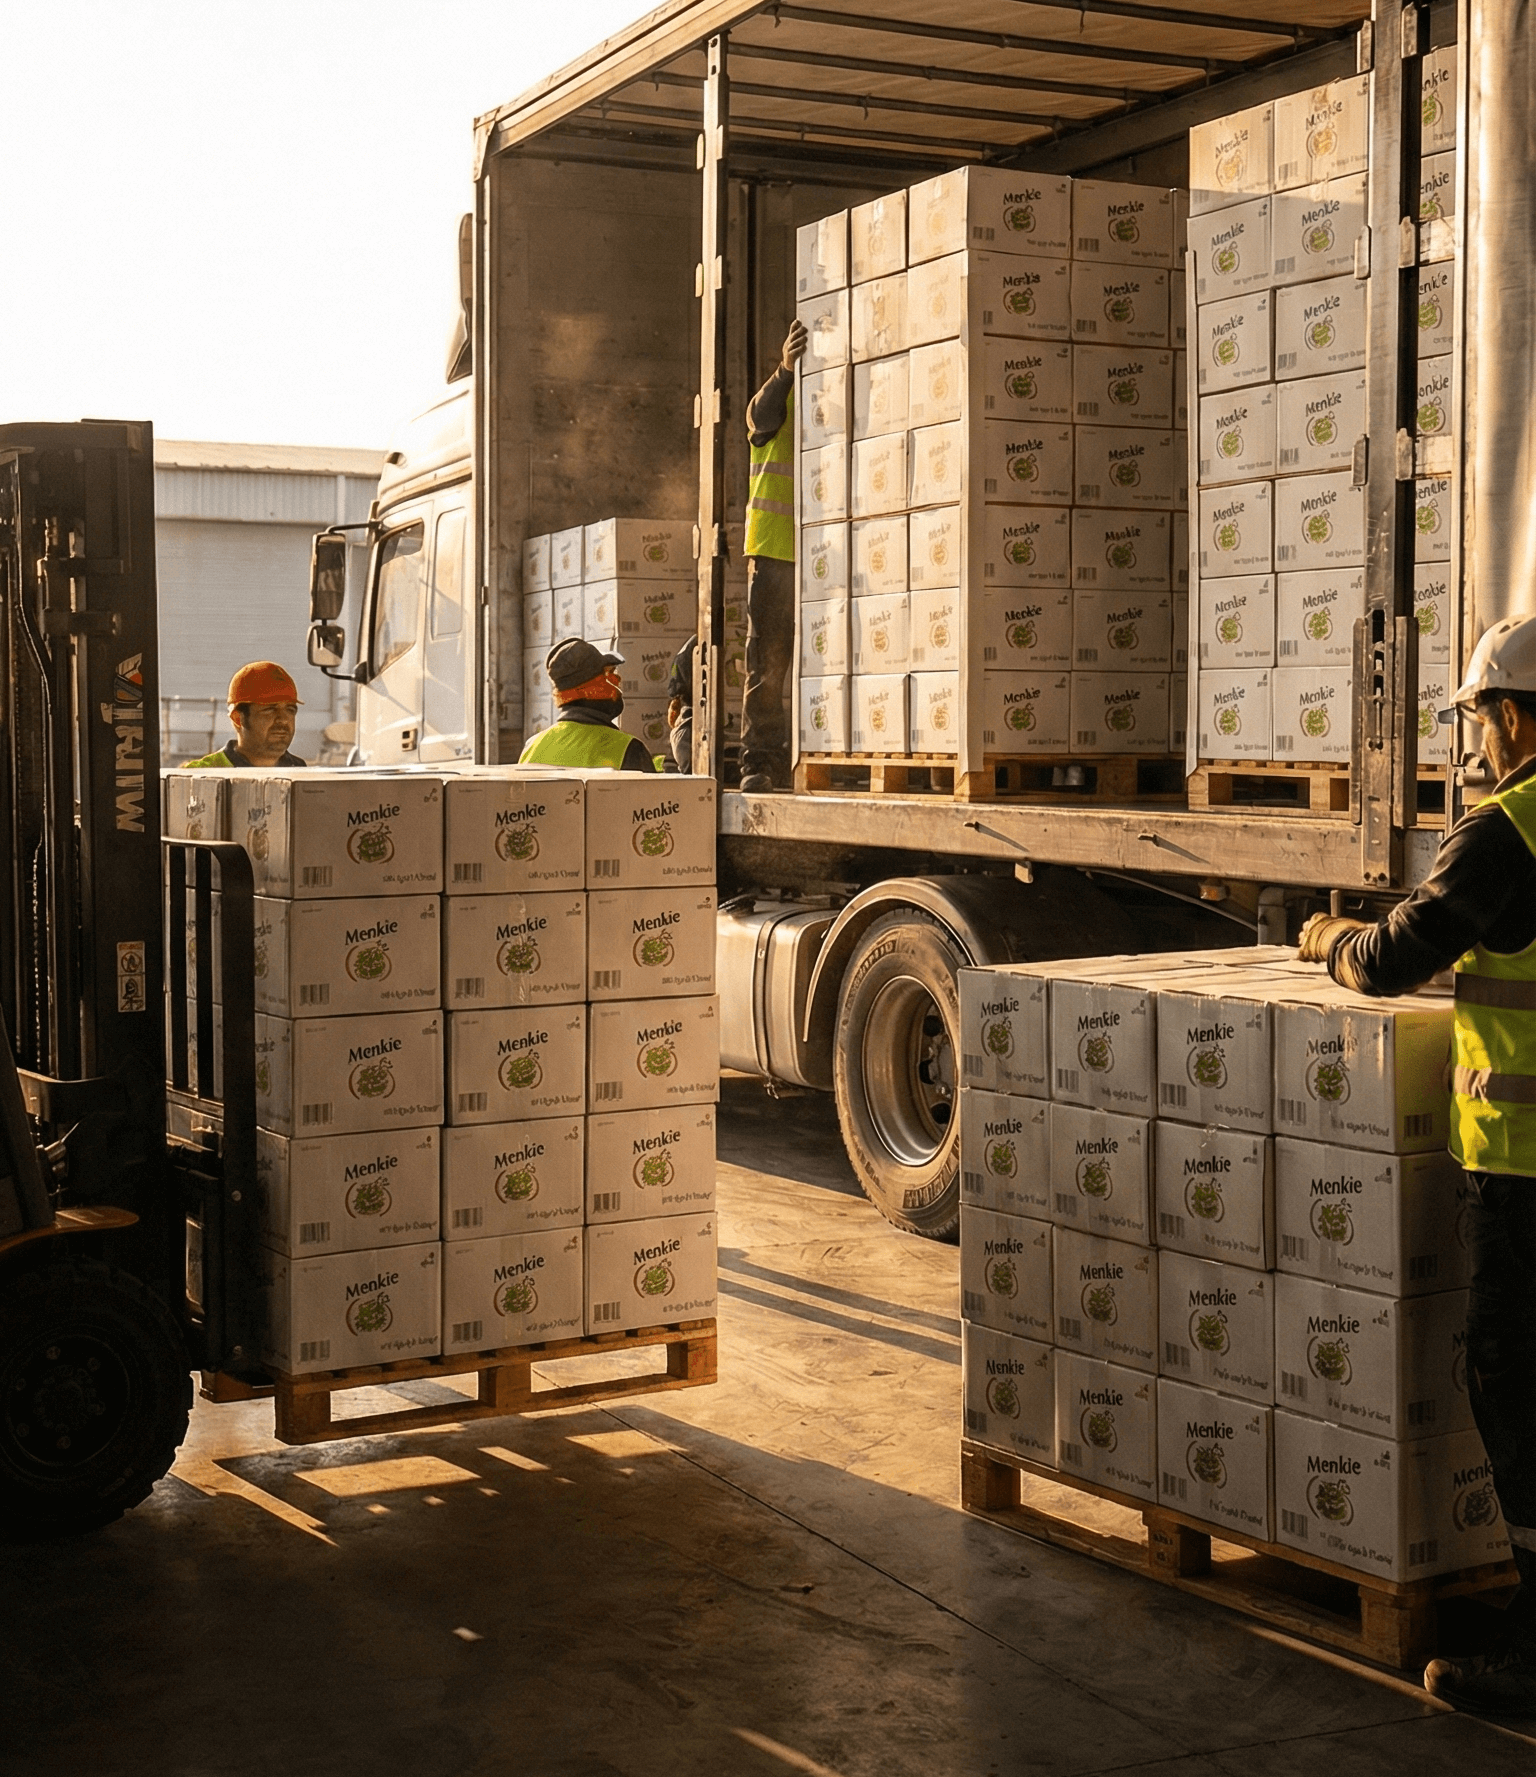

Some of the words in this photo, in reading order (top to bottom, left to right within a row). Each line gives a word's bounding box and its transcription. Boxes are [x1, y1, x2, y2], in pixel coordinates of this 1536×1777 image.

[1302, 200, 1340, 226] Menkie
[346, 803, 400, 828] Menkie
[495, 803, 547, 827] Menkie
[632, 801, 680, 824] Menkie
[345, 920, 398, 946] Menkie
[495, 916, 548, 941] Menkie
[632, 911, 681, 934] Menkie
[636, 1020, 683, 1045] Menkie
[1077, 1010, 1121, 1032] Menkie
[497, 1030, 549, 1056] Menkie
[1186, 1022, 1235, 1045] Menkie
[348, 1037, 402, 1064] Menkie
[632, 1129, 681, 1155] Menkie
[1075, 1138, 1119, 1156] Menkie
[494, 1143, 545, 1170] Menkie
[1183, 1156, 1231, 1176] Menkie
[344, 1154, 398, 1183] Menkie
[1309, 1176, 1363, 1198] Menkie
[633, 1237, 681, 1265] Menkie
[984, 1238, 1023, 1256] Menkie
[493, 1254, 545, 1283] Menkie
[1079, 1262, 1124, 1281] Menkie
[345, 1271, 399, 1300] Menkie
[1188, 1288, 1237, 1307] Menkie
[1307, 1315, 1360, 1334] Menkie
[985, 1359, 1025, 1376] Menkie
[1079, 1388, 1124, 1406] Menkie
[1186, 1421, 1234, 1440] Menkie
[1307, 1455, 1361, 1475] Menkie
